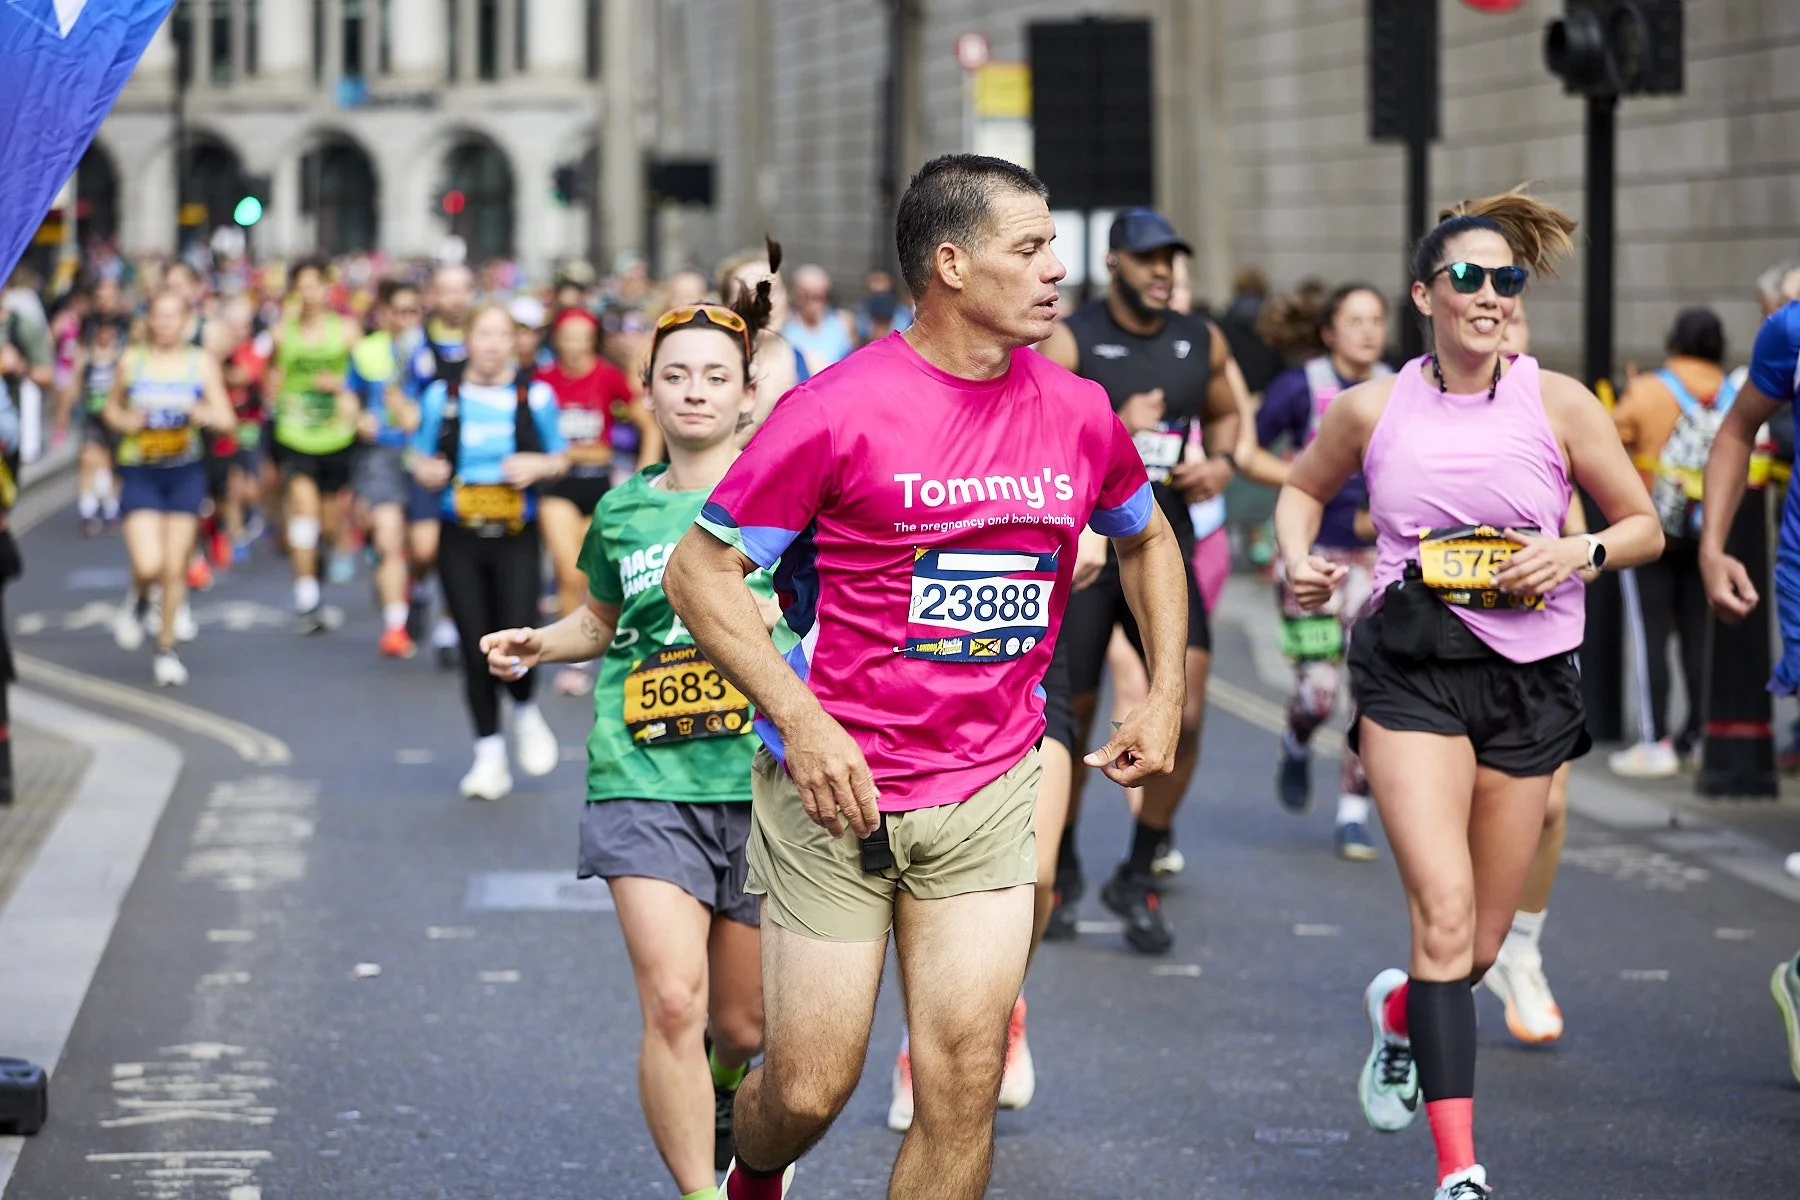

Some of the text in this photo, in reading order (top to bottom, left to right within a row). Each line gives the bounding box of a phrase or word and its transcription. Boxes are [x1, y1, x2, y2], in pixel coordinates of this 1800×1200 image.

[893, 467, 1074, 509] Tommy's
[893, 522, 917, 532] The
[920, 517, 985, 533] pregnancy
[987, 513, 1009, 525] and
[1042, 513, 1075, 528] charity
[1443, 549, 1522, 578] 575
[623, 568, 665, 600] CANCE
[919, 583, 1041, 622] 23888
[640, 670, 727, 710] 5683
